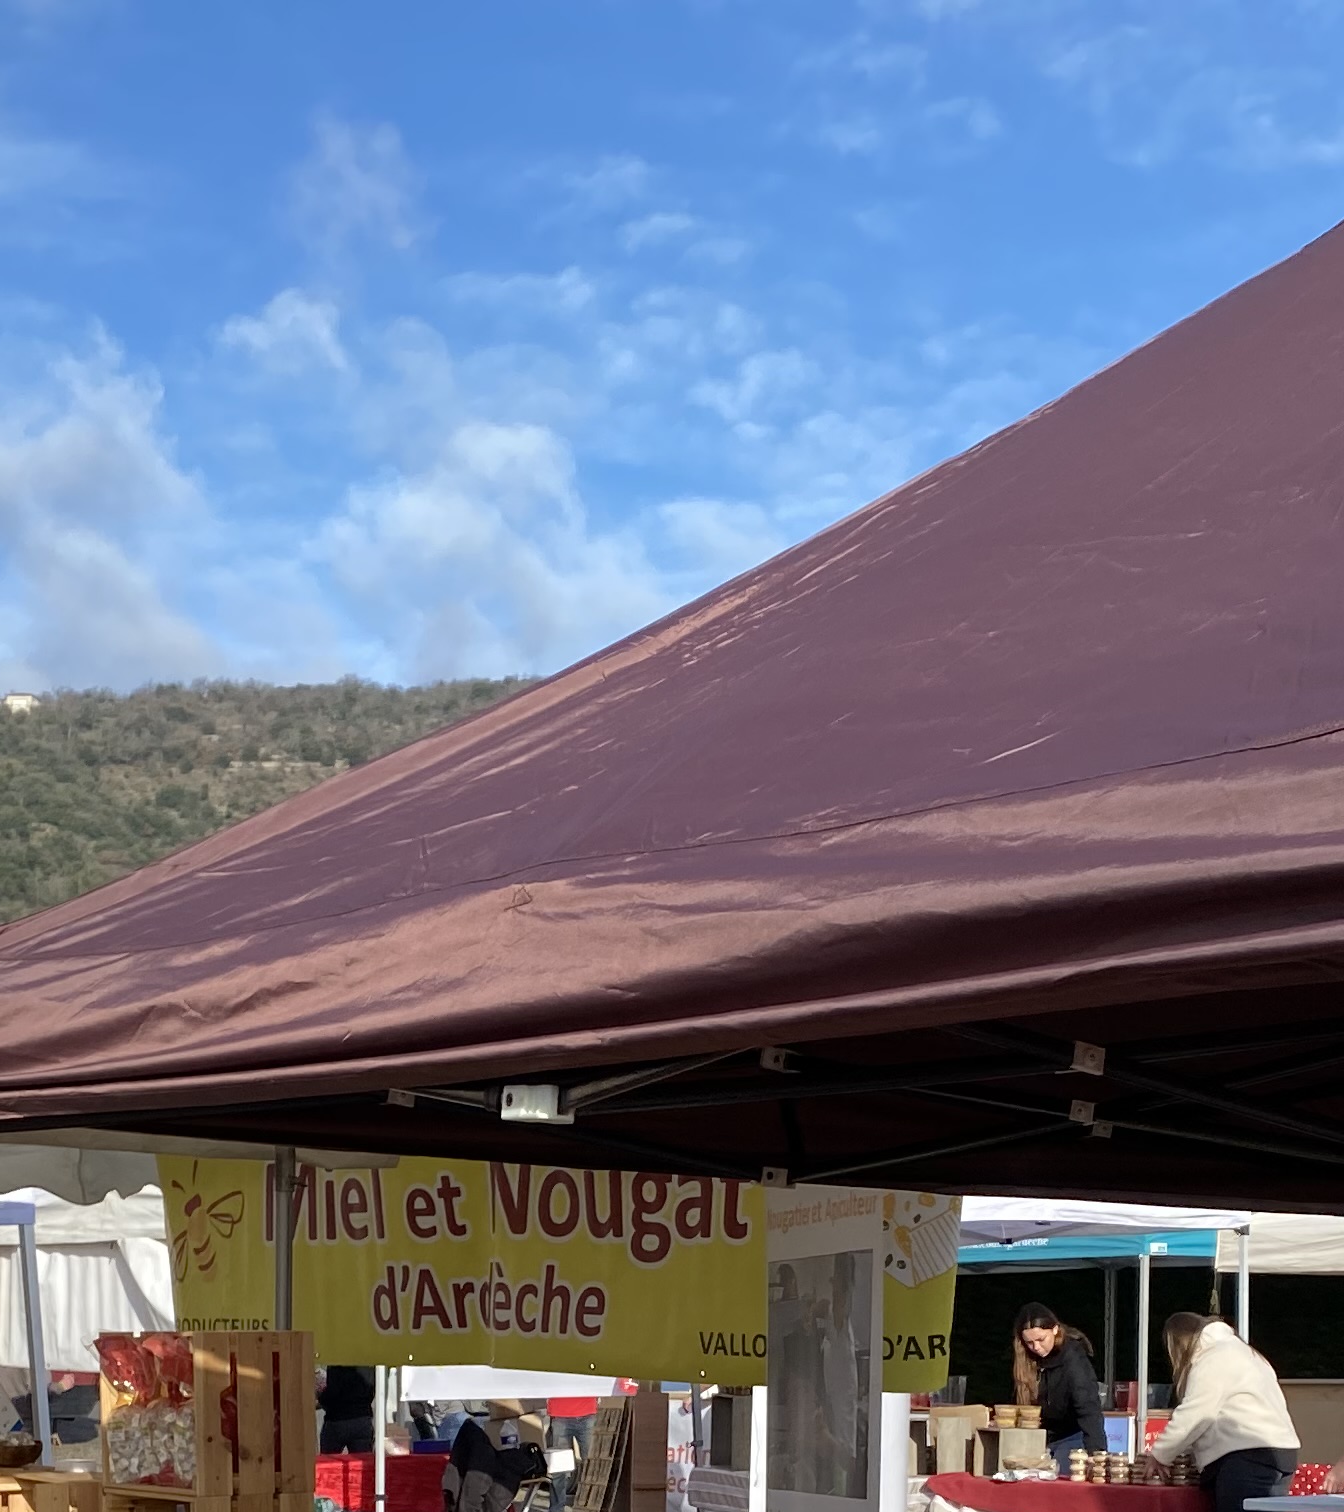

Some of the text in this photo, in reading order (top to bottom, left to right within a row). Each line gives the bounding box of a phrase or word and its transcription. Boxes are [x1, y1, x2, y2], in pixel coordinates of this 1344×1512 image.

[406, 1173, 468, 1237] et
[490, 1161, 749, 1264] Nougat
[699, 1331, 950, 1362] VALLO D'AR
